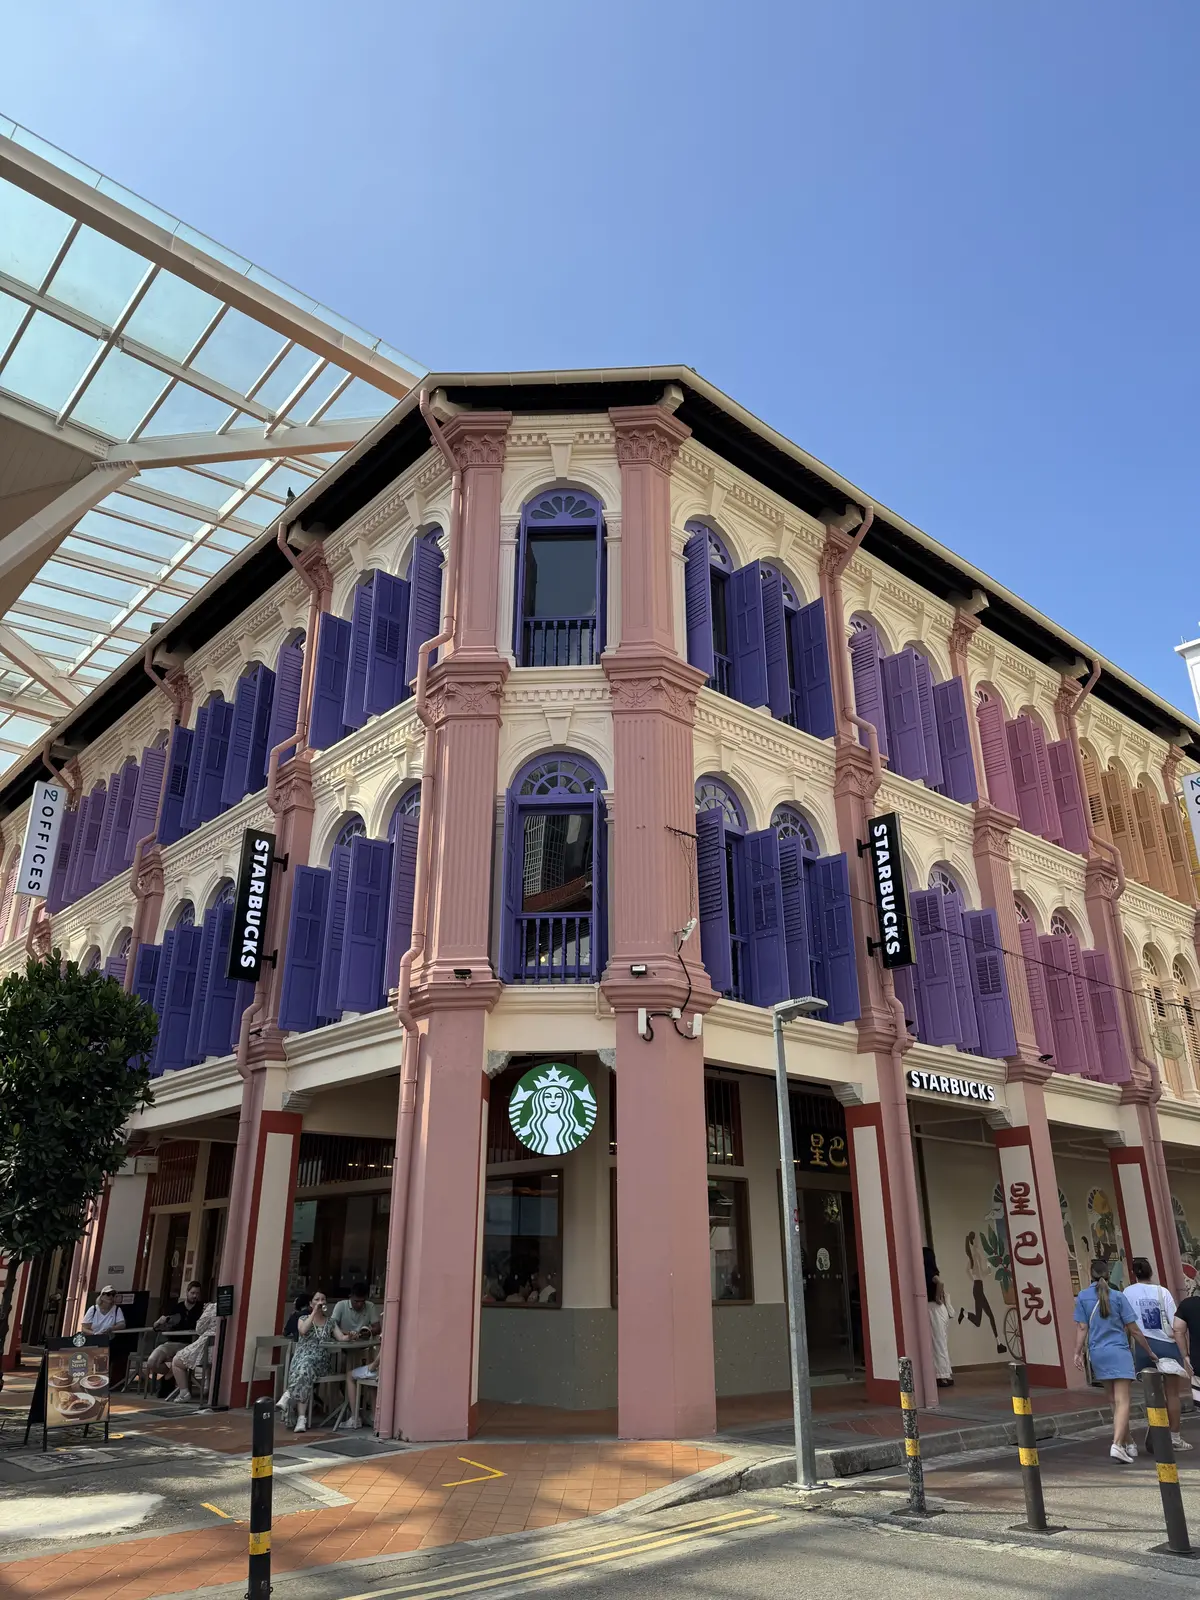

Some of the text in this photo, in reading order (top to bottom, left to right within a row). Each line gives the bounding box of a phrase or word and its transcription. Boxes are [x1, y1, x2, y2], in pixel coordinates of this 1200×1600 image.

[28, 806, 54, 891] OFFICES
[240, 839, 270, 968] STARBUCKS
[873, 823, 901, 955] STARBUCKS
[910, 1070, 995, 1102] STARBUCKS
[1009, 1181, 1052, 1326] 星巴克
